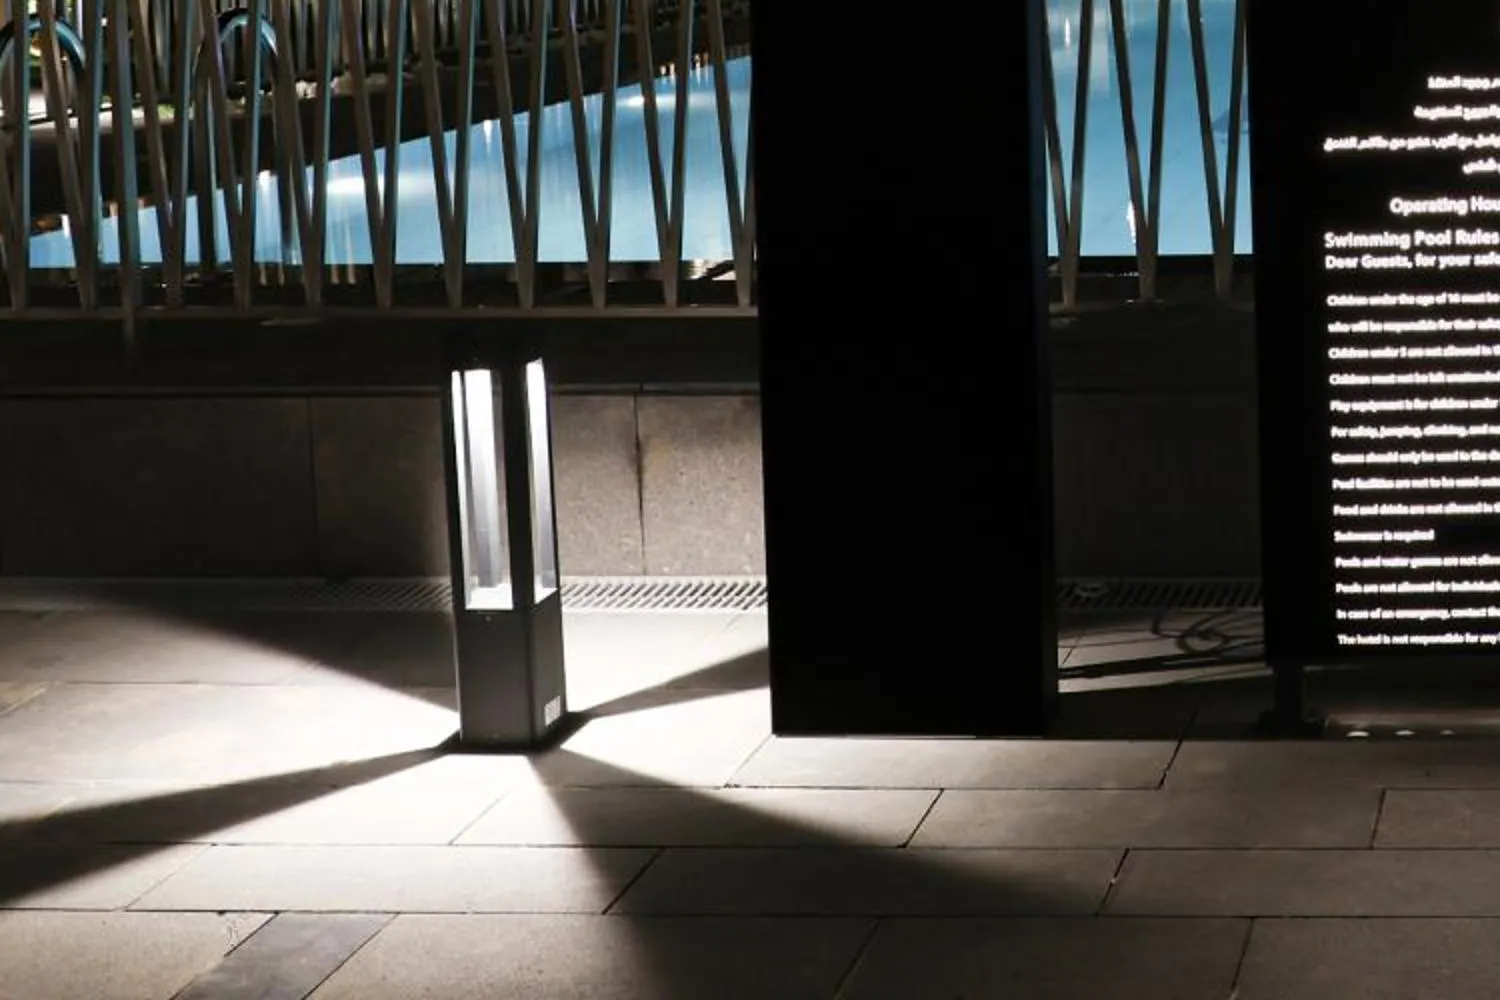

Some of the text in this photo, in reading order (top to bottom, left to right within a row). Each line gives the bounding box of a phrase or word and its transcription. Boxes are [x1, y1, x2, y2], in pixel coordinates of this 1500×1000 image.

[1390, 198, 1468, 216] Operating
[1325, 230, 1500, 249] Swimming Pool Rules
